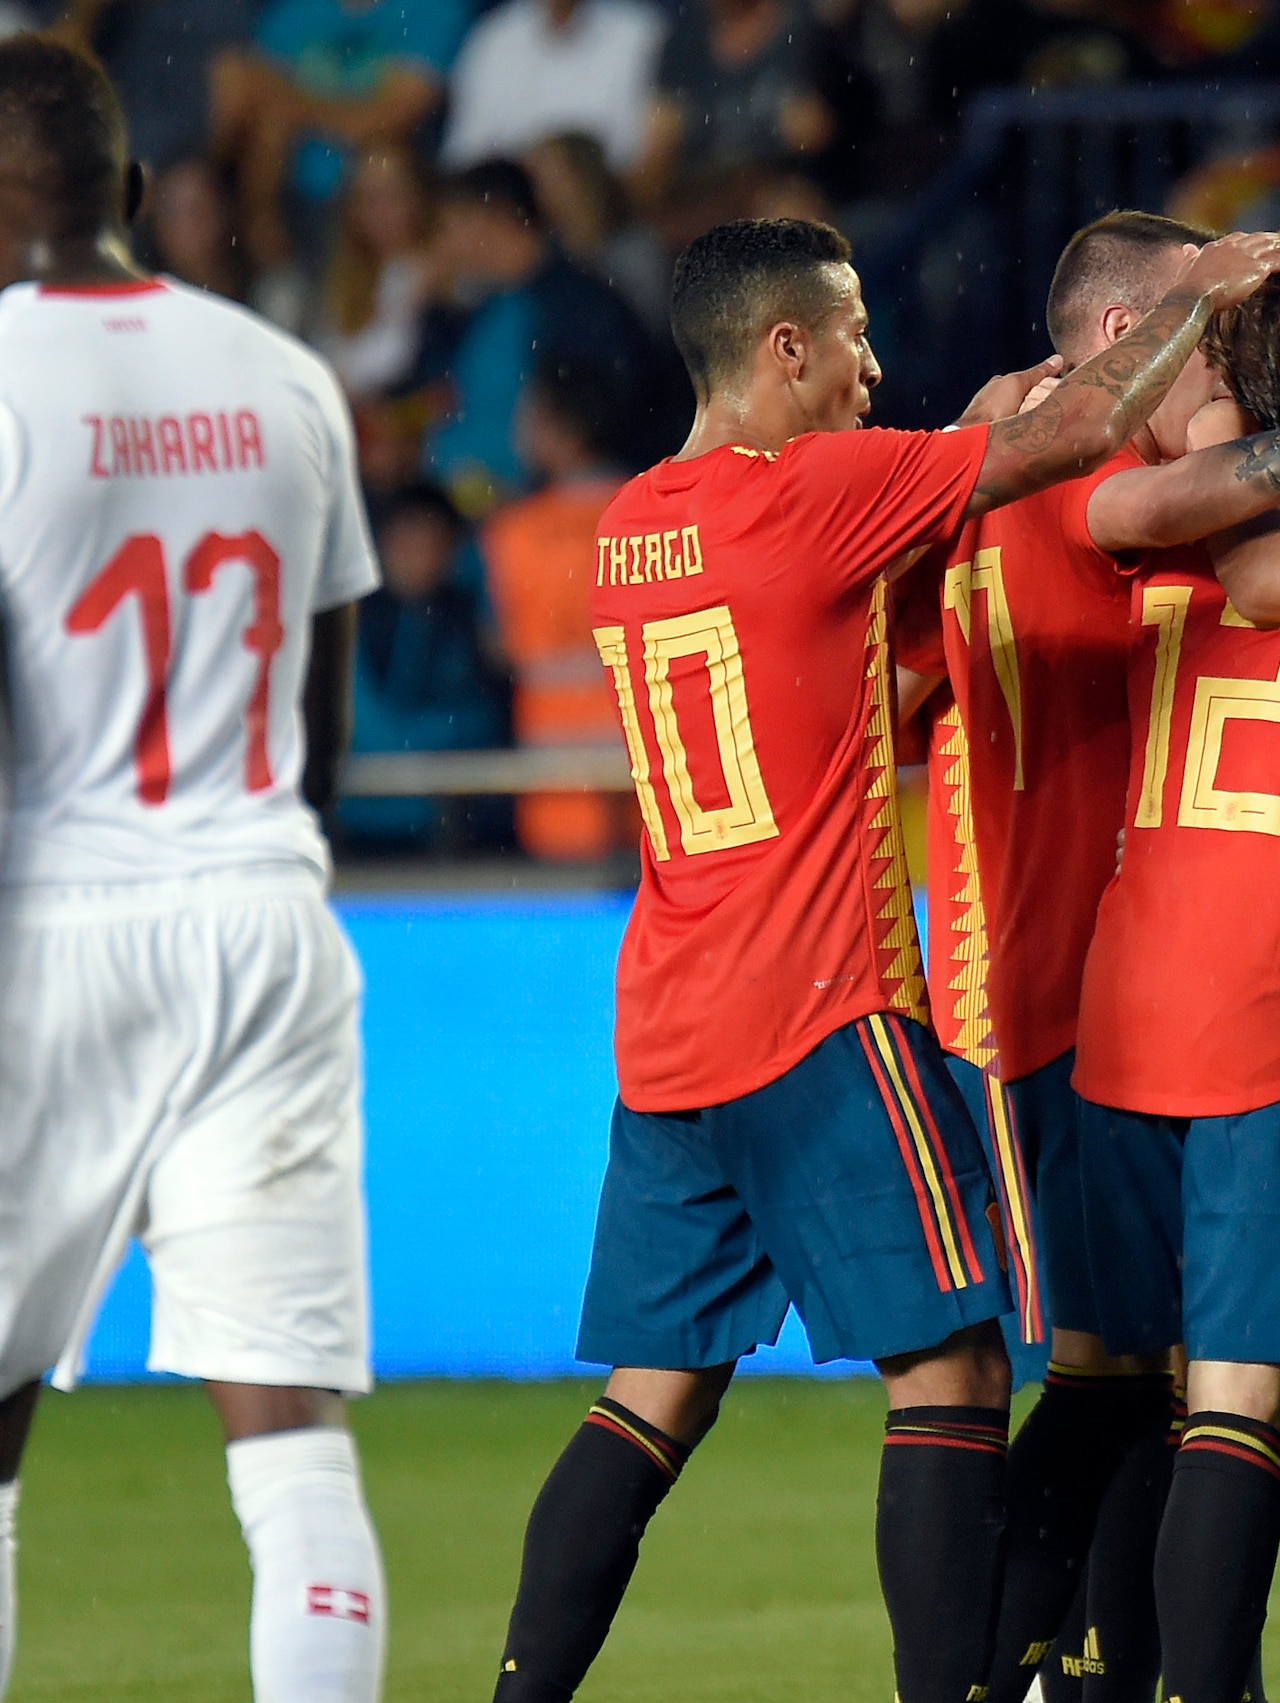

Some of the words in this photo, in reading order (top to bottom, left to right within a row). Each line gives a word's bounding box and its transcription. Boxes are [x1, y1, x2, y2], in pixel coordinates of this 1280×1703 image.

[82, 408, 266, 478] ZAKARIA
[597, 525, 704, 587] THIAGO
[63, 531, 284, 809] 17
[592, 606, 780, 861] 10
